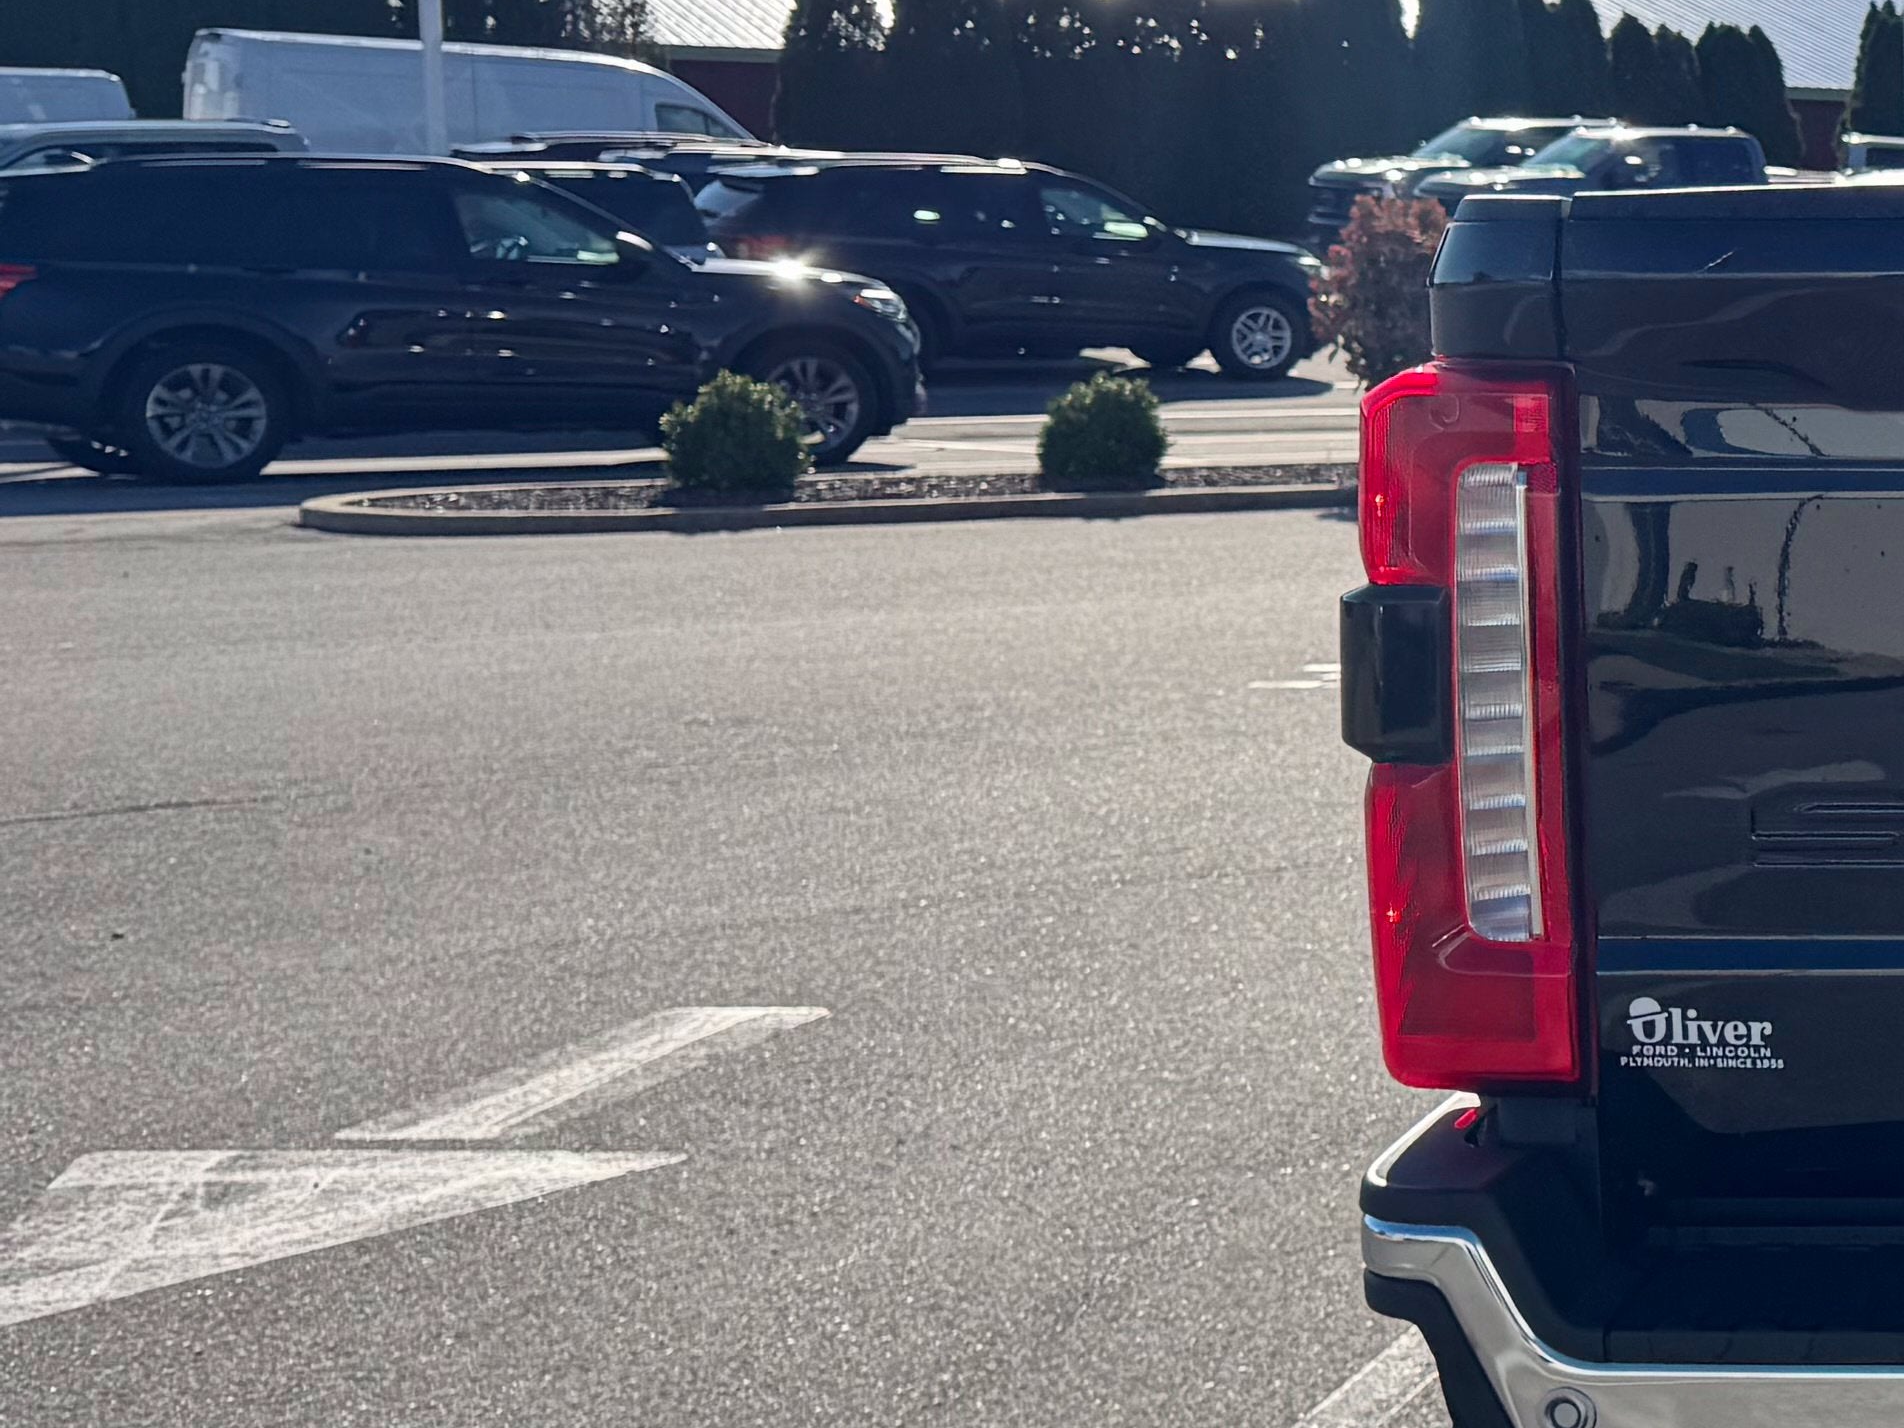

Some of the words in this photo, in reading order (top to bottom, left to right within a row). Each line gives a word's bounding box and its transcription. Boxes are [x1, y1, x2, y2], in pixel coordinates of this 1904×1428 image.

[1627, 996, 1773, 1046] Oliver
[1631, 1044, 1679, 1057] FORD
[1696, 1045, 1772, 1058] LINCOLN
